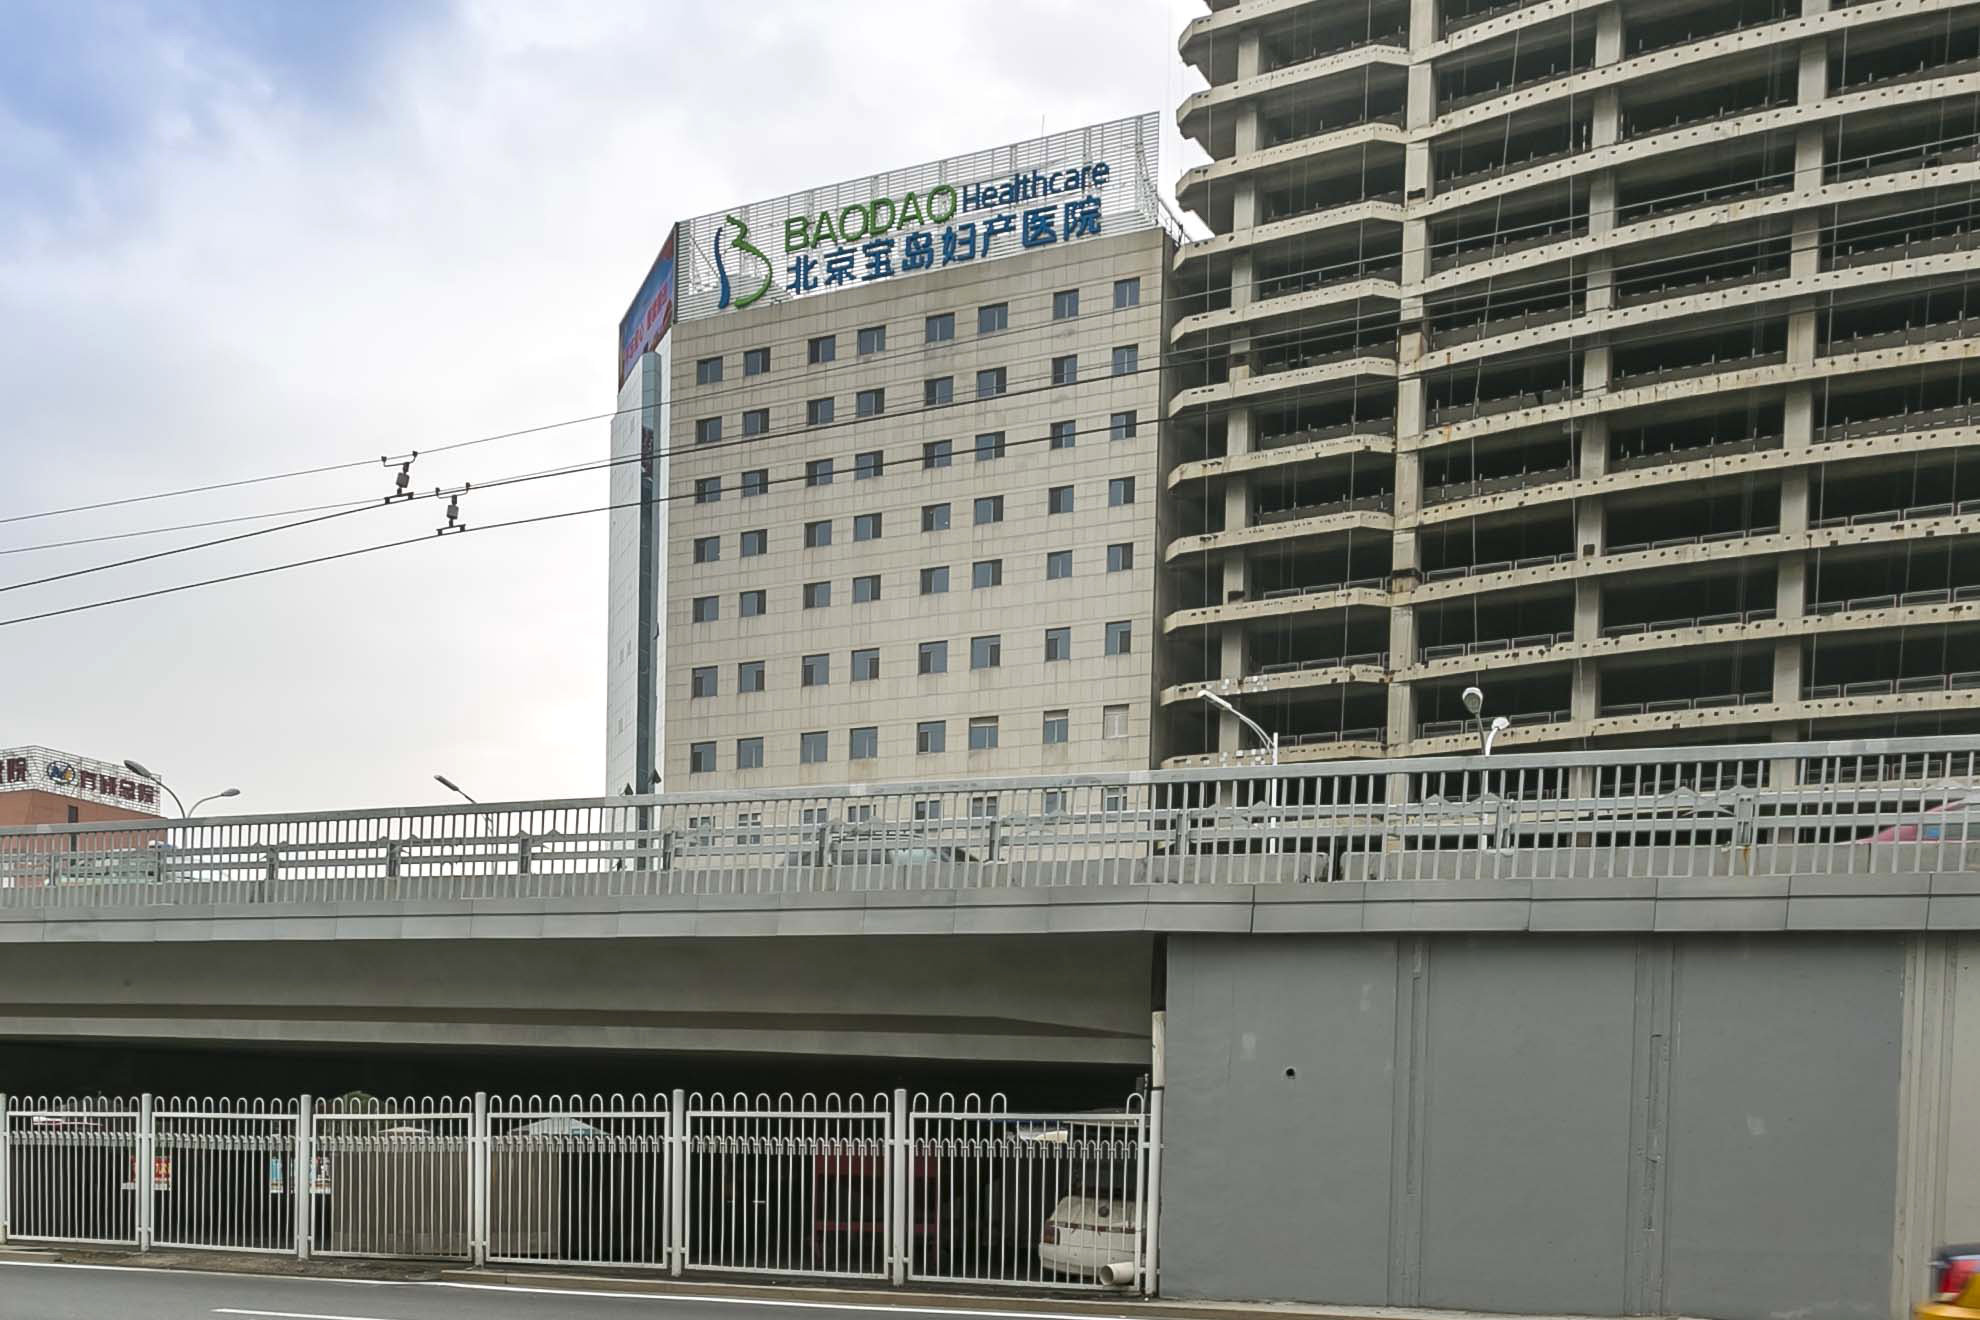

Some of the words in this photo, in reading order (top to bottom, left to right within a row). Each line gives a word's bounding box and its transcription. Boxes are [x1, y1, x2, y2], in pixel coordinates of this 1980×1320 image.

[784, 184, 957, 253] BAODAO
[963, 162, 1110, 213] Healthcare
[786, 195, 1102, 295] 北京宝岛妇产医院
